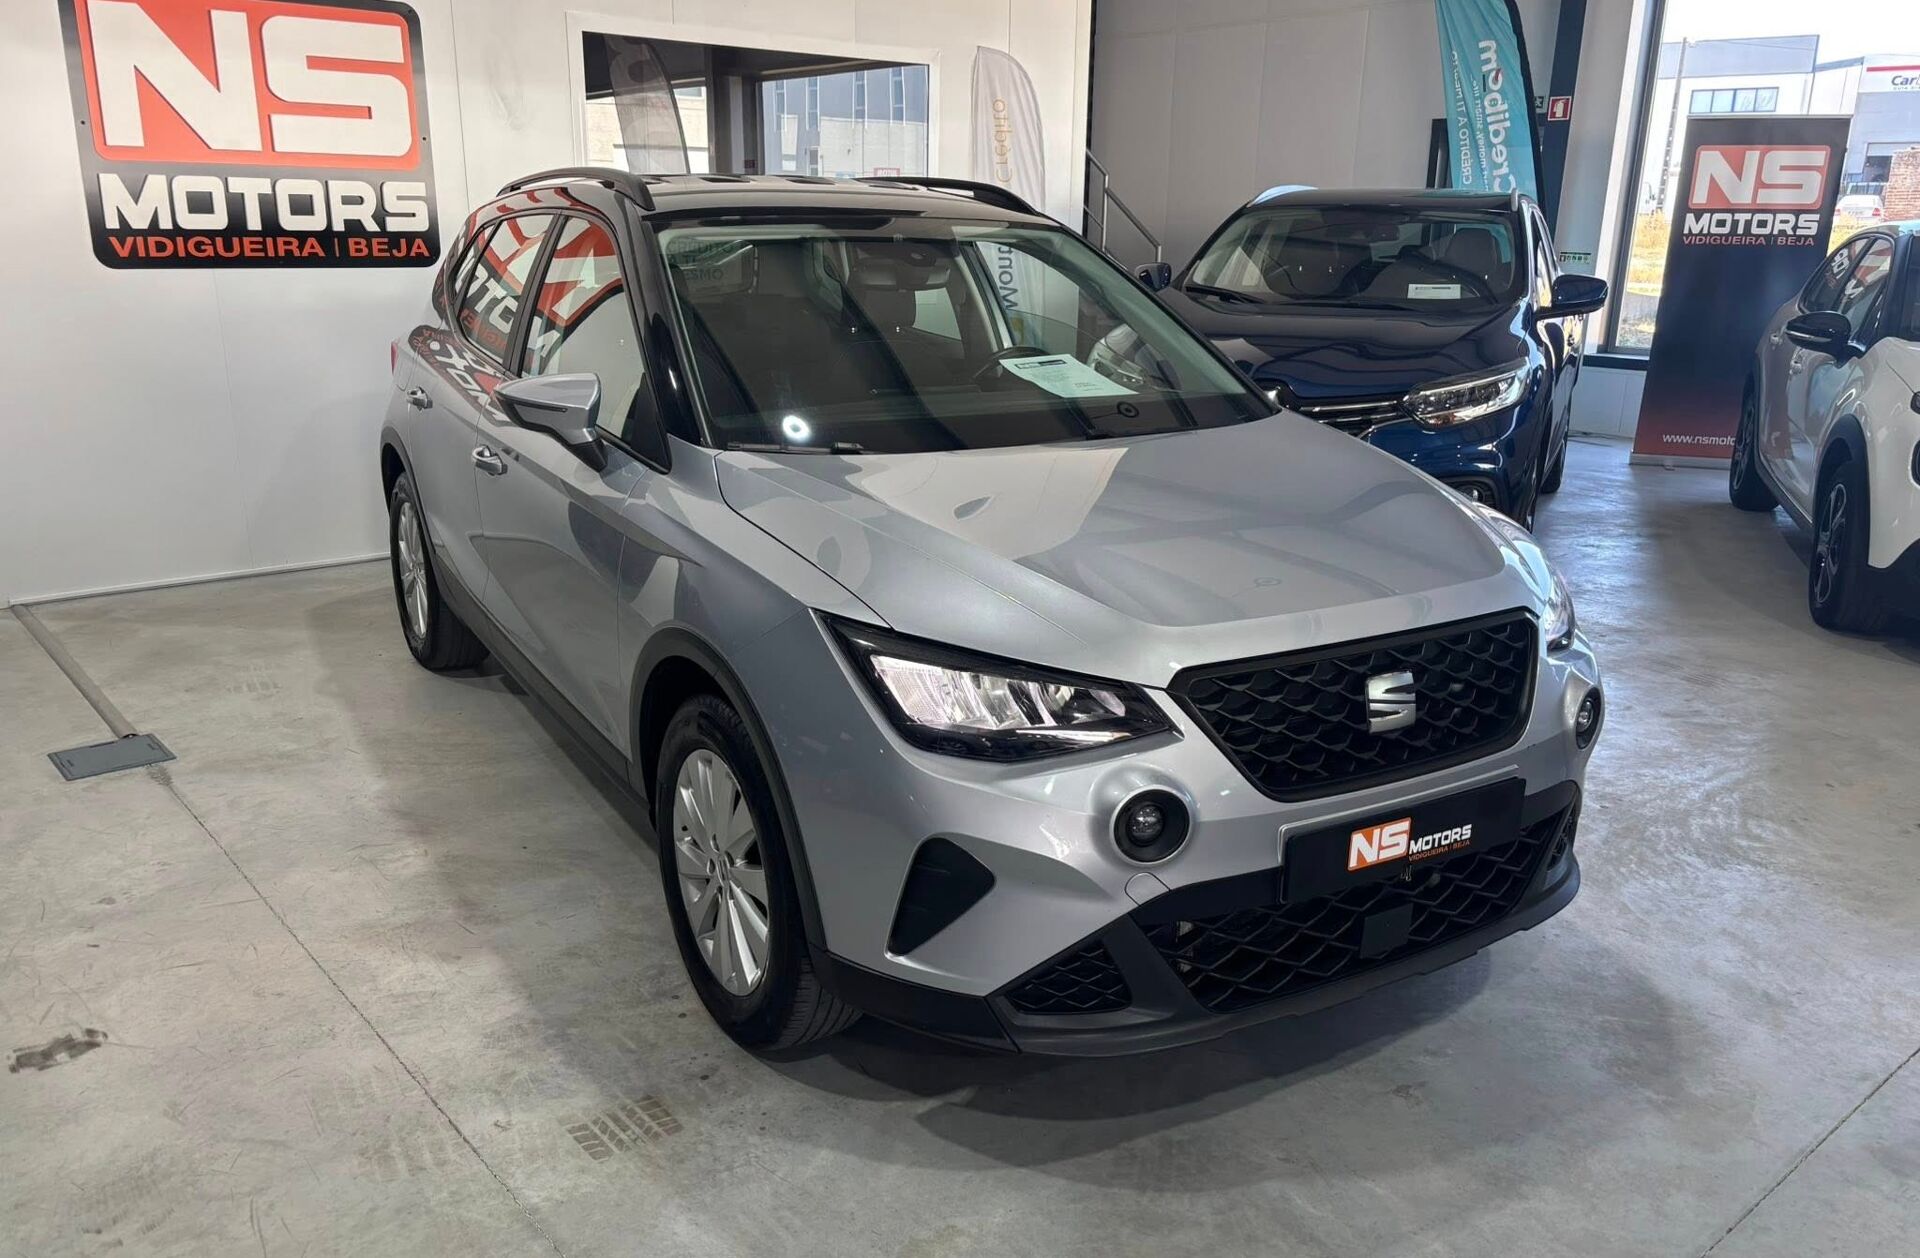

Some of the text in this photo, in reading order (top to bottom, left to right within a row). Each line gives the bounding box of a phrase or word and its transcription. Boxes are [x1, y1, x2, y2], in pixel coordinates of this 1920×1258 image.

[87, 0, 413, 157] NS
[1692, 150, 1827, 204] NS
[98, 173, 430, 232] MOTORS
[1683, 213, 1820, 235] MOTORS
[1683, 236, 1815, 246] VIDIGUEIRA BEJA
[108, 236, 430, 258] VIDIGUEIRA BEJA
[1349, 820, 1411, 868] NS
[1409, 824, 1473, 855] MOTORS
